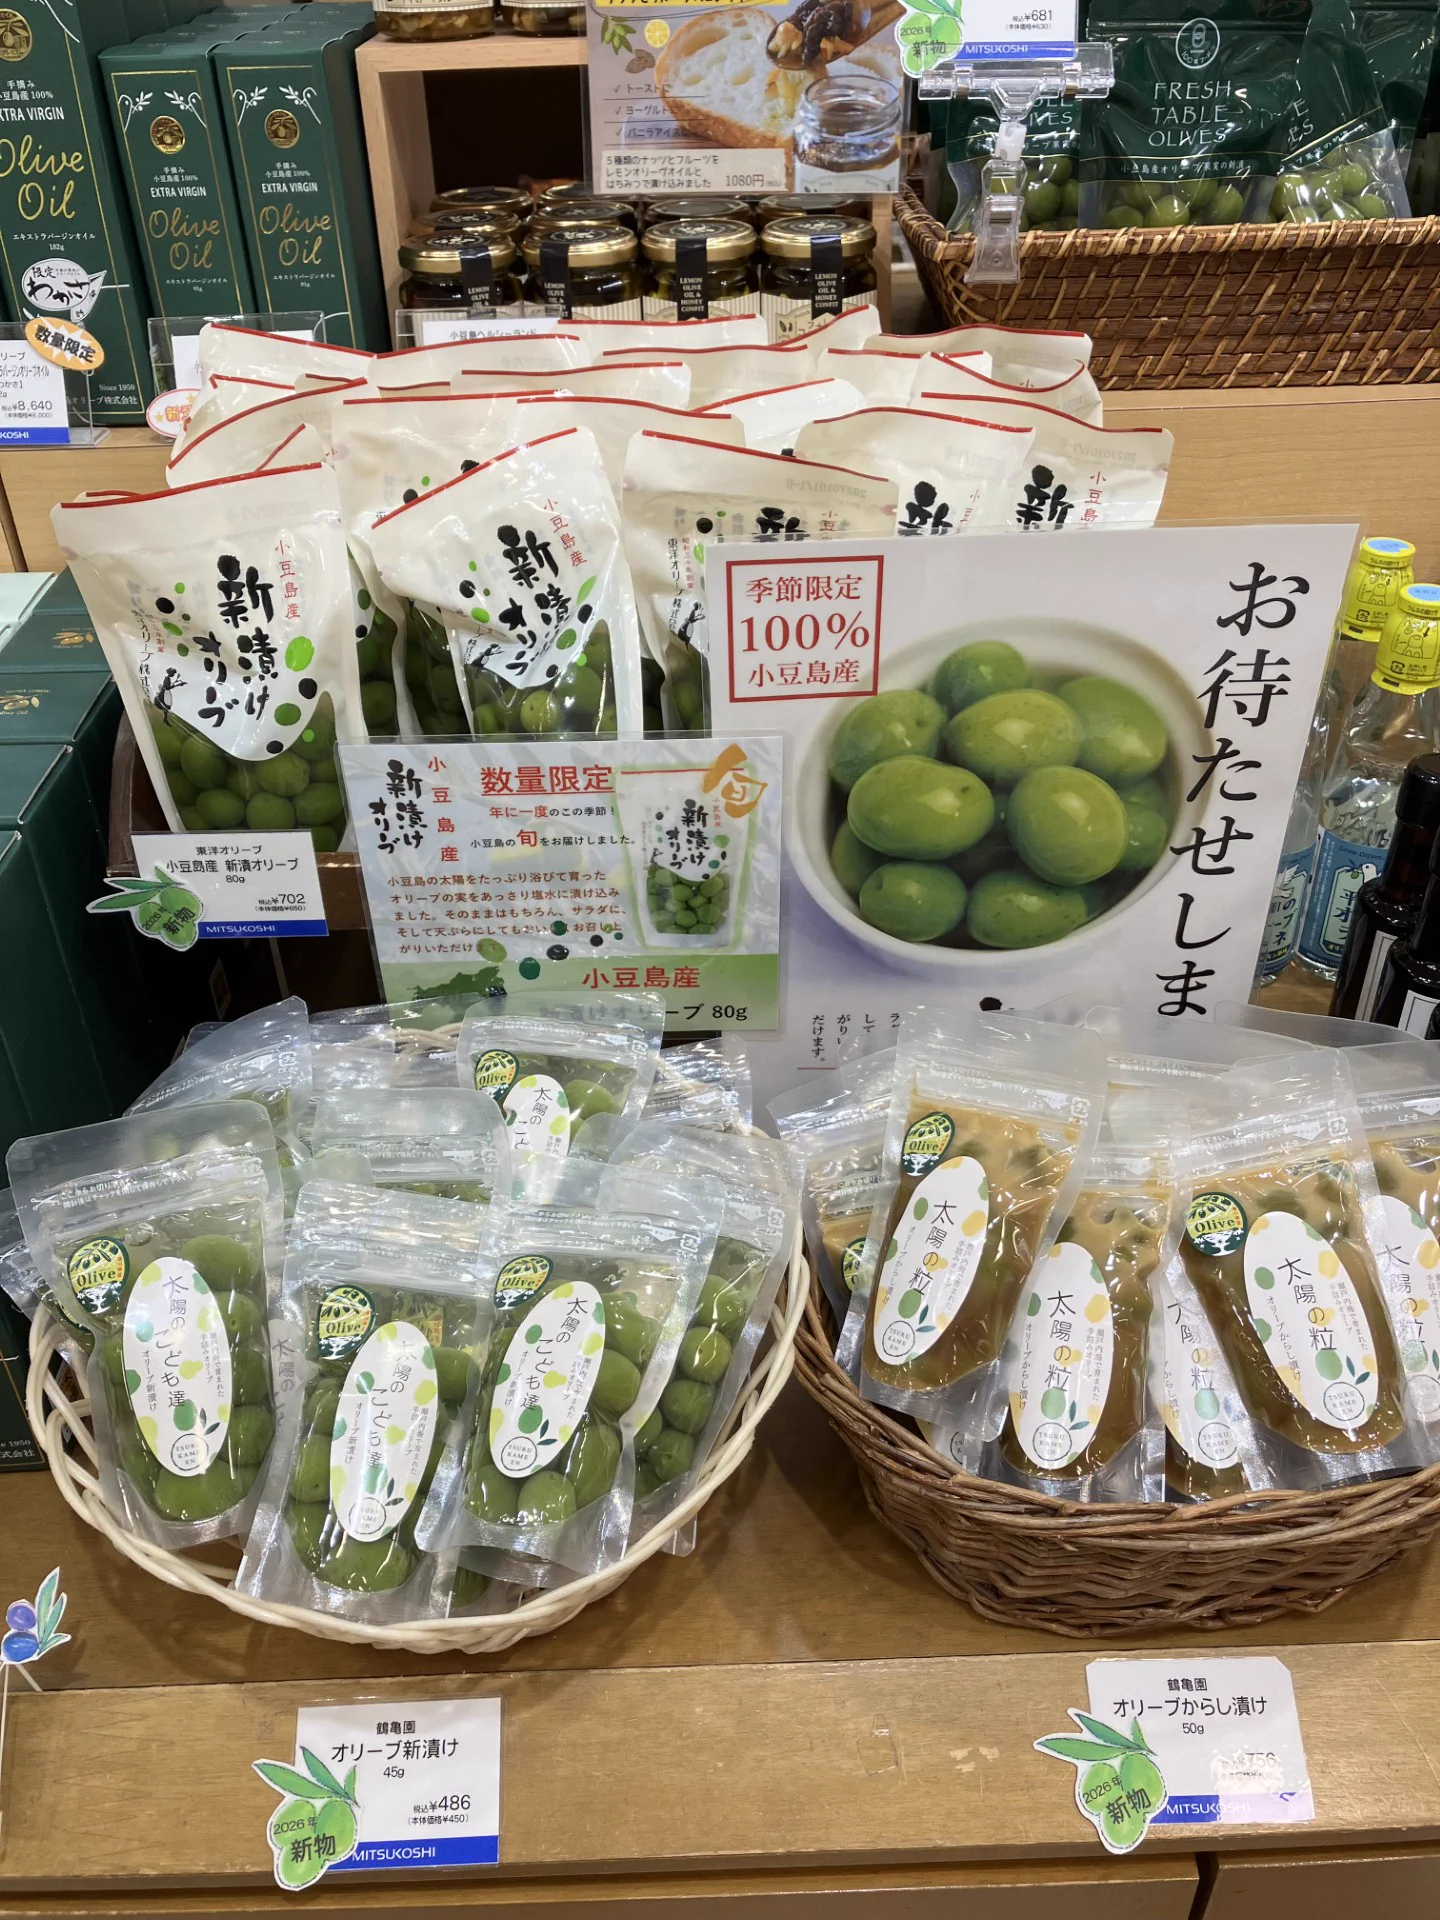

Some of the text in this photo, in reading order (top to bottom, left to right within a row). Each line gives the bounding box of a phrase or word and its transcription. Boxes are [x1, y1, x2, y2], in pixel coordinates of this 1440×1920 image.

[912, 40, 947, 58] 新物
[965, 45, 1028, 54] MITSUKOSHI
[31, 90, 54, 99] 100%
[1154, 80, 1231, 100] FRESH
[26, 106, 65, 120] VIRGIN
[1151, 104, 1229, 125] TABLE
[1148, 127, 1227, 148] OLIVES
[150, 185, 207, 198] EXTRA VIRGIN
[261, 181, 318, 194] EXTRA VIRGIN
[726, 174, 764, 187] 1080円
[18, 180, 76, 221] Oil
[149, 207, 221, 239] Olive
[259, 203, 332, 235] Olive
[169, 240, 213, 270] Oil
[278, 235, 323, 266] Oil
[32, 266, 56, 279] 限定
[467, 286, 490, 295] LEMON
[471, 293, 490, 301] OLIVE
[35, 324, 97, 363] 数量限定
[1080, 470, 1107, 530] 小豆島
[543, 497, 588, 568] 小豆島産
[274, 539, 301, 620] 小豆島産
[745, 574, 863, 604] 季節限定
[216, 554, 278, 721] 新漬け
[739, 615, 870, 654] 100%
[192, 631, 239, 728] オリーブ
[747, 658, 861, 689] 小豆島産
[480, 764, 615, 793] 数量限定
[701, 743, 768, 819] 旬
[1155, 561, 1310, 1017] お待たせしま
[385, 759, 428, 849] 新漬け
[427, 756, 460, 863] 小豆島産
[368, 797, 400, 854] オリーブ
[470, 829, 640, 850] 小豆島の旬をお届けしました。
[681, 799, 710, 866] 新漬け
[195, 845, 263, 856] 東洋オリーブ
[666, 826, 688, 870] オリーブ
[166, 858, 299, 873] 小豆島産 新漬オリーブ
[225, 875, 246, 884] 80g
[387, 870, 606, 888] 小豆島の太陽をたっぷり浴びて育った
[390, 887, 620, 904] オリーブの実をあっさり塩水に漬け込み
[162, 906, 196, 935] 新物
[206, 925, 276, 933] MITSUKOSHI
[582, 965, 701, 989] 小豆島産
[712, 1005, 748, 1021] 80g
[812, 1014, 826, 1062] だけます。
[479, 1073, 508, 1086] Olive
[529, 1087, 553, 1126] 太陽の
[908, 1139, 939, 1151] Olive
[1194, 1218, 1236, 1233] Olive
[907, 1200, 957, 1297] 太陽の粒
[77, 1269, 116, 1287] Olive
[502, 1275, 535, 1288] Olive
[162, 1275, 189, 1331] 太陽の
[1278, 1257, 1337, 1350] 太陽の粒
[325, 1320, 361, 1336] Olive
[555, 1297, 588, 1343] 太陽の
[1044, 1290, 1077, 1392] 太陽の粒
[1266, 1295, 1302, 1381] オリーブからし漬け
[154, 1329, 187, 1408] こども達
[271, 1338, 296, 1393] 太陽の
[520, 1338, 554, 1410] こども達
[1018, 1322, 1033, 1409] オリーブからし漬け
[141, 1350, 157, 1412] オリーブ新漬け
[344, 1402, 364, 1464] オリーブ新漬け
[1167, 1677, 1208, 1692] 鶴亀園
[1113, 1696, 1267, 1717] オリーブからし漬け
[376, 1721, 416, 1735] 鶴亀園
[1182, 1722, 1205, 1735] 50g
[331, 1738, 459, 1763] オリーブ新漬け
[383, 1766, 405, 1779] 45g
[413, 1795, 471, 1814] 税込¥486
[1105, 1788, 1151, 1825] 新物
[1166, 1802, 1251, 1816] MITSUKOSHI
[290, 1833, 336, 1864] 新物
[352, 1846, 436, 1861] MITSUKOSHI
